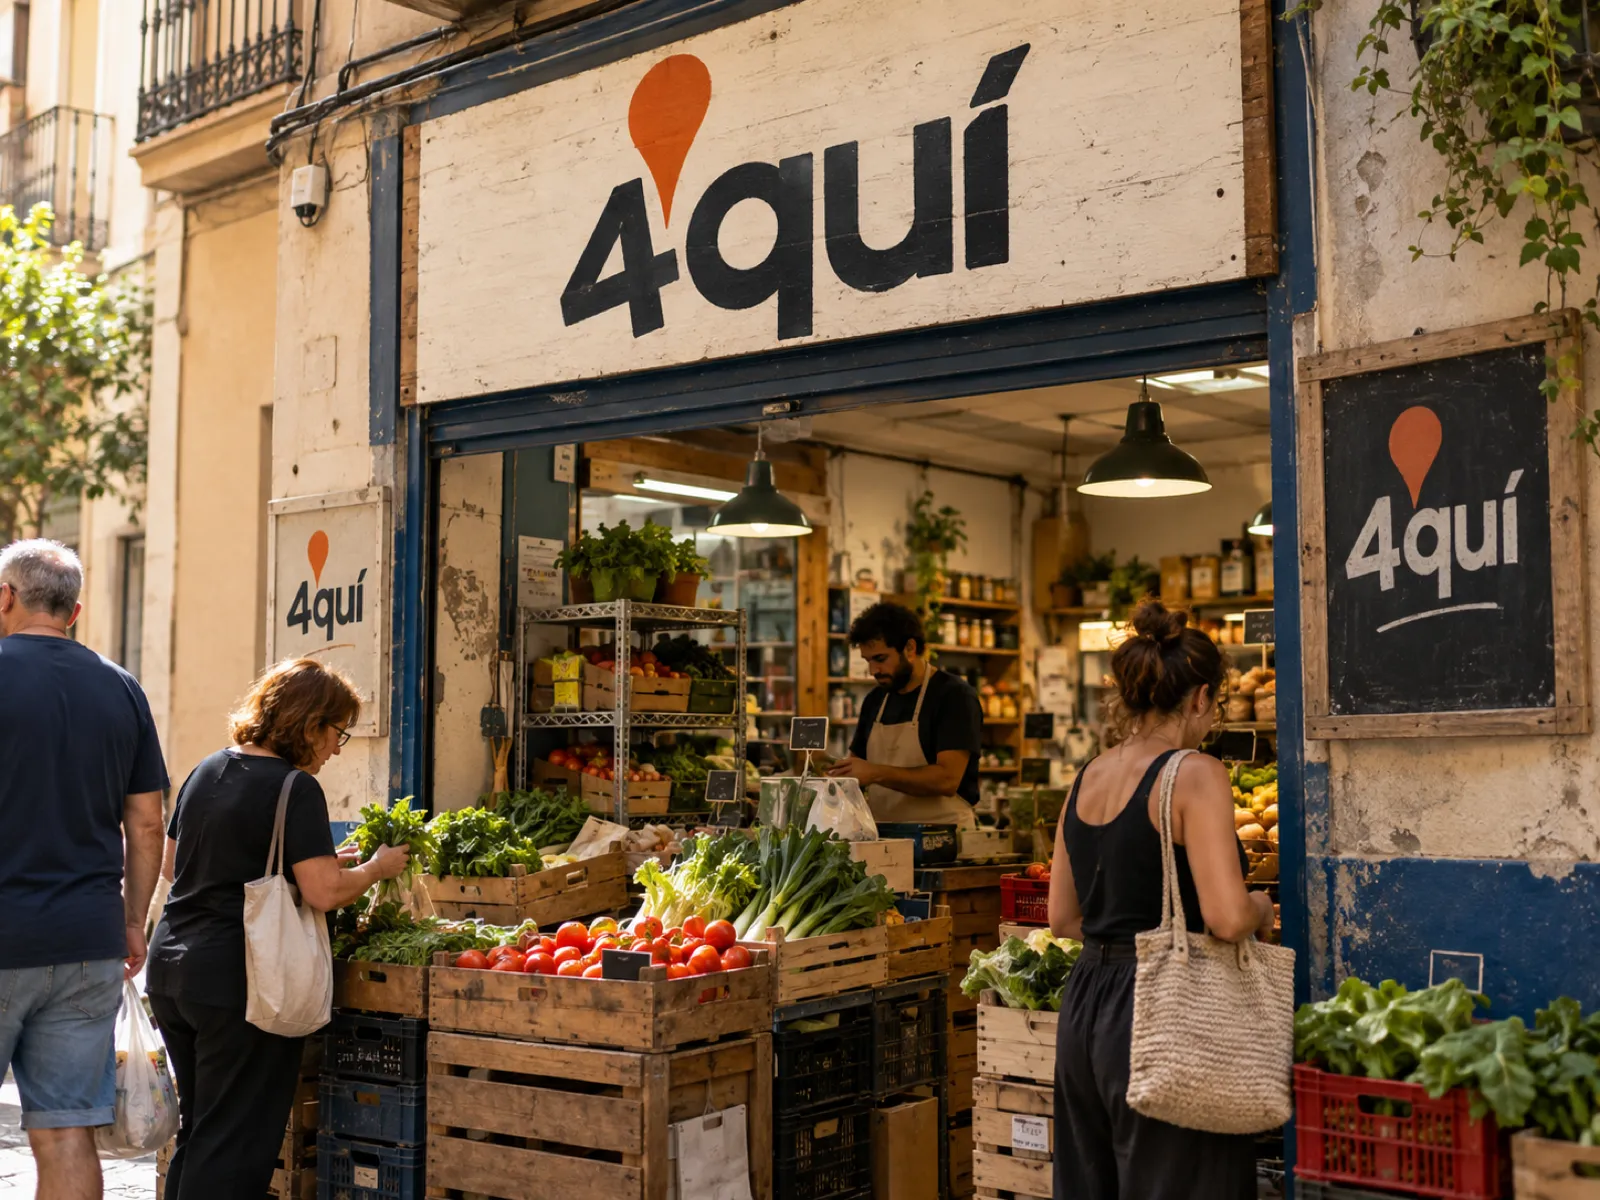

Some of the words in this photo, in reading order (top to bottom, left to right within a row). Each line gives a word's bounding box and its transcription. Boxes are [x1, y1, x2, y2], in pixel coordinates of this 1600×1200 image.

[560, 43, 1030, 340] 4quí
[1346, 469, 1524, 599] 4quí
[287, 568, 367, 641] 4quí
